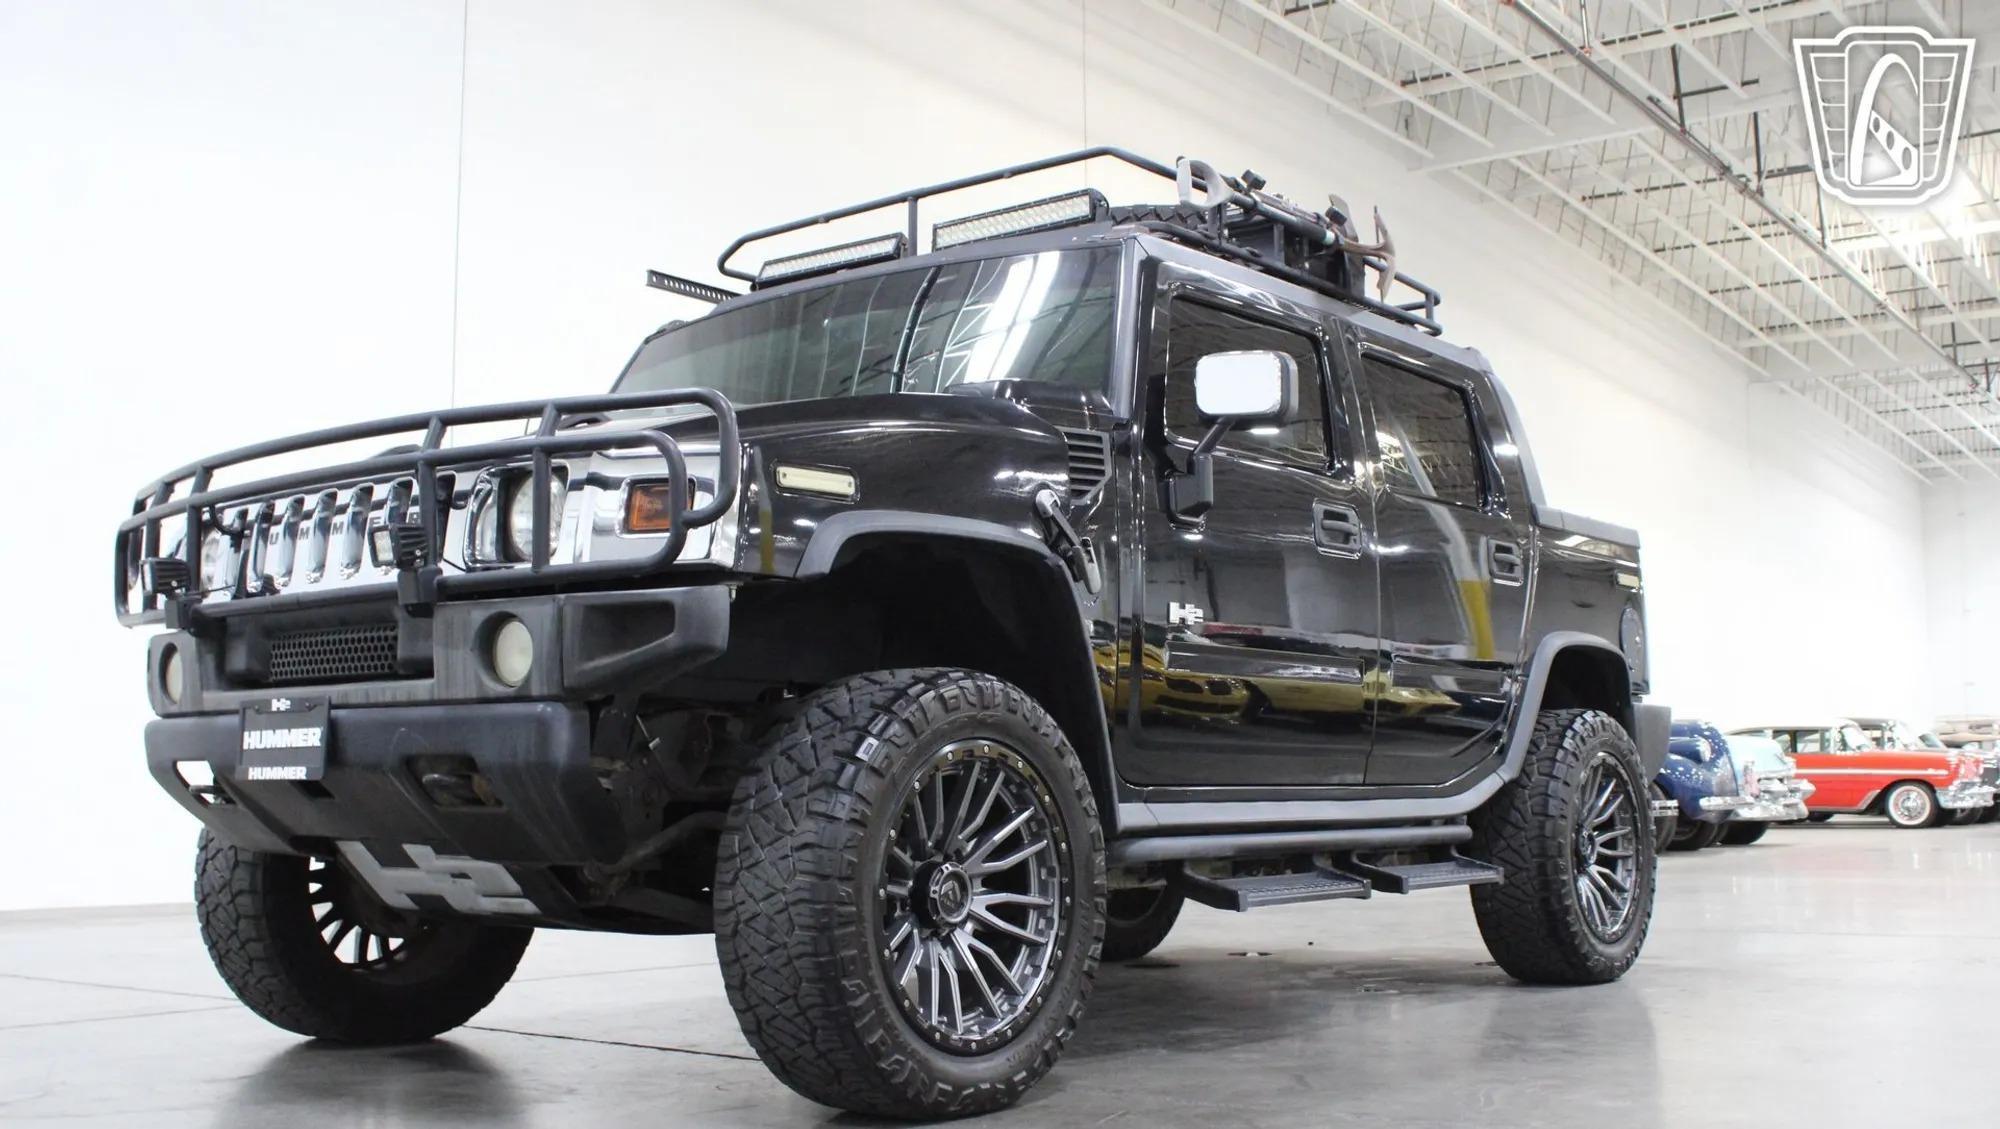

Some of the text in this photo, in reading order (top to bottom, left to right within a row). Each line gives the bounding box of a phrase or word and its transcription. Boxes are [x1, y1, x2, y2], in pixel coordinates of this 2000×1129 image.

[1169, 601, 1204, 625] H2
[243, 727, 322, 750] HUMMER
[248, 766, 307, 780] HUMMER
